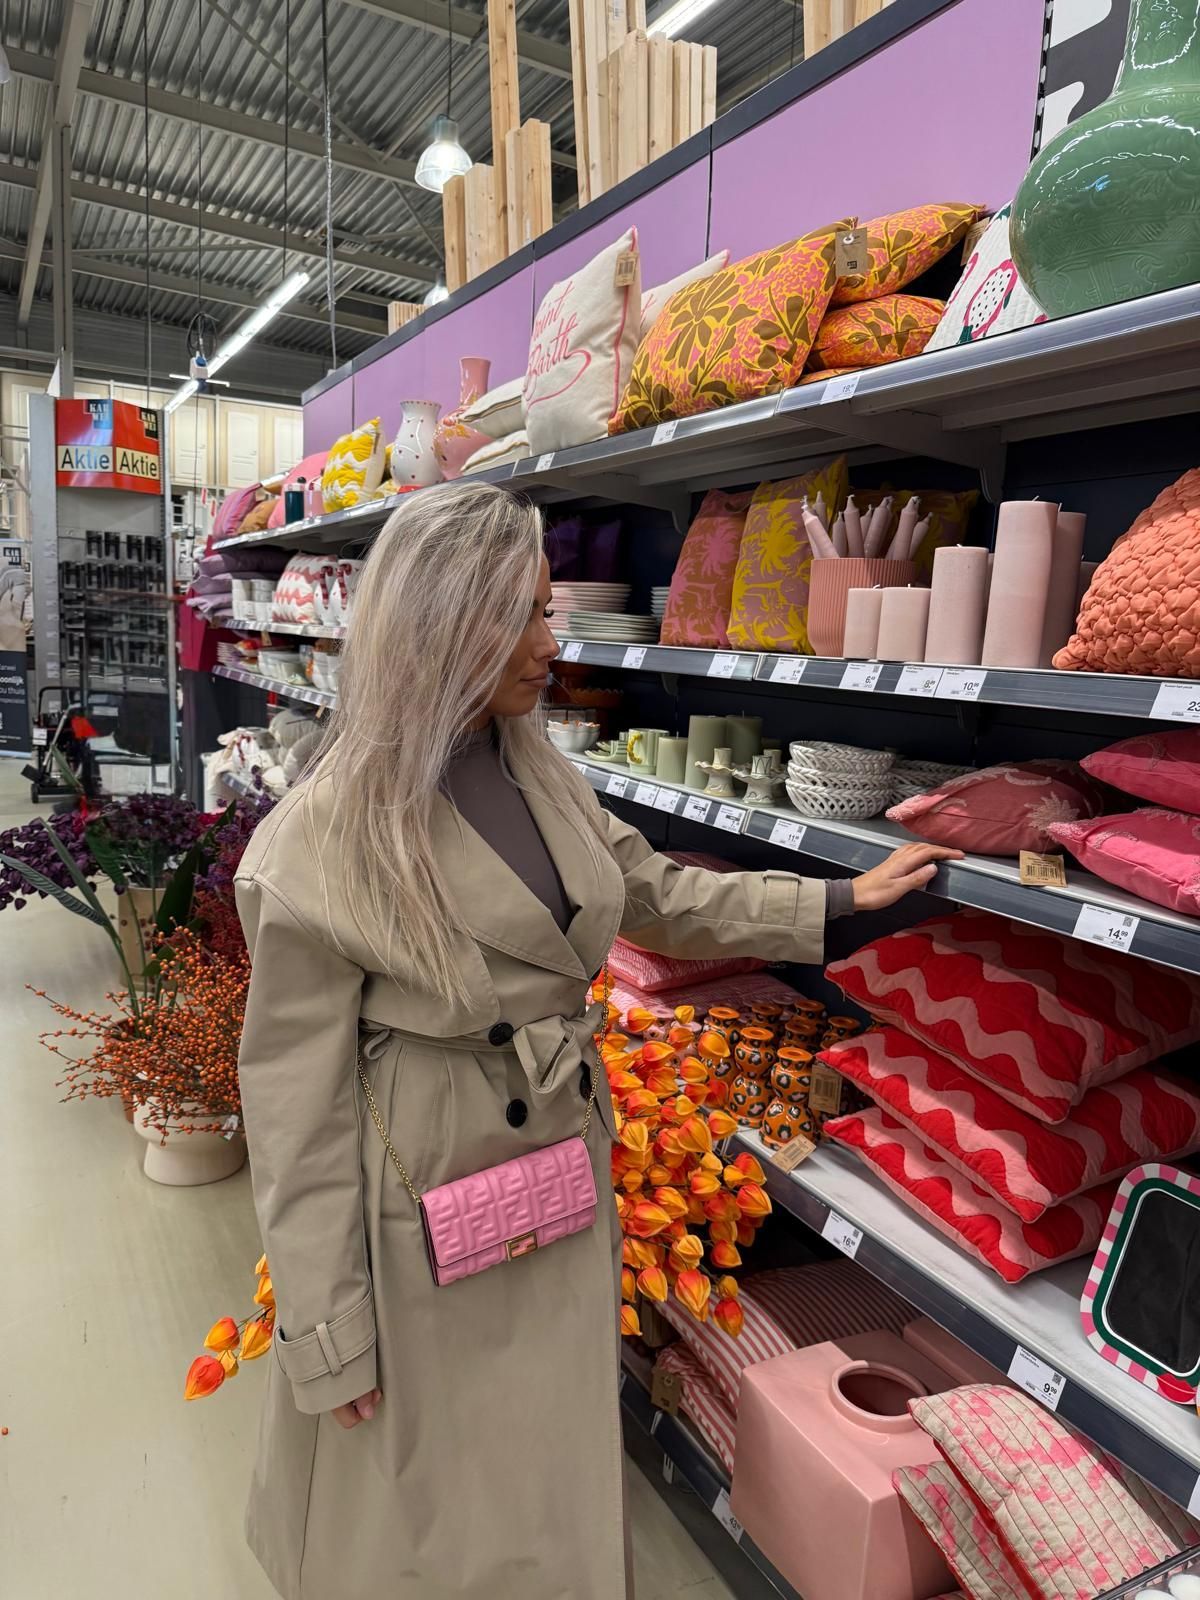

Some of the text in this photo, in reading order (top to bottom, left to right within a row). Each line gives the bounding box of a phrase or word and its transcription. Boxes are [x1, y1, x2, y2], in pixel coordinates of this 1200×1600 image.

[61, 447, 110, 469] Aktie
[120, 450, 157, 477] Aktie
[1108, 927, 1129, 940] 14.99
[1043, 1382, 1057, 1396] 9.99
